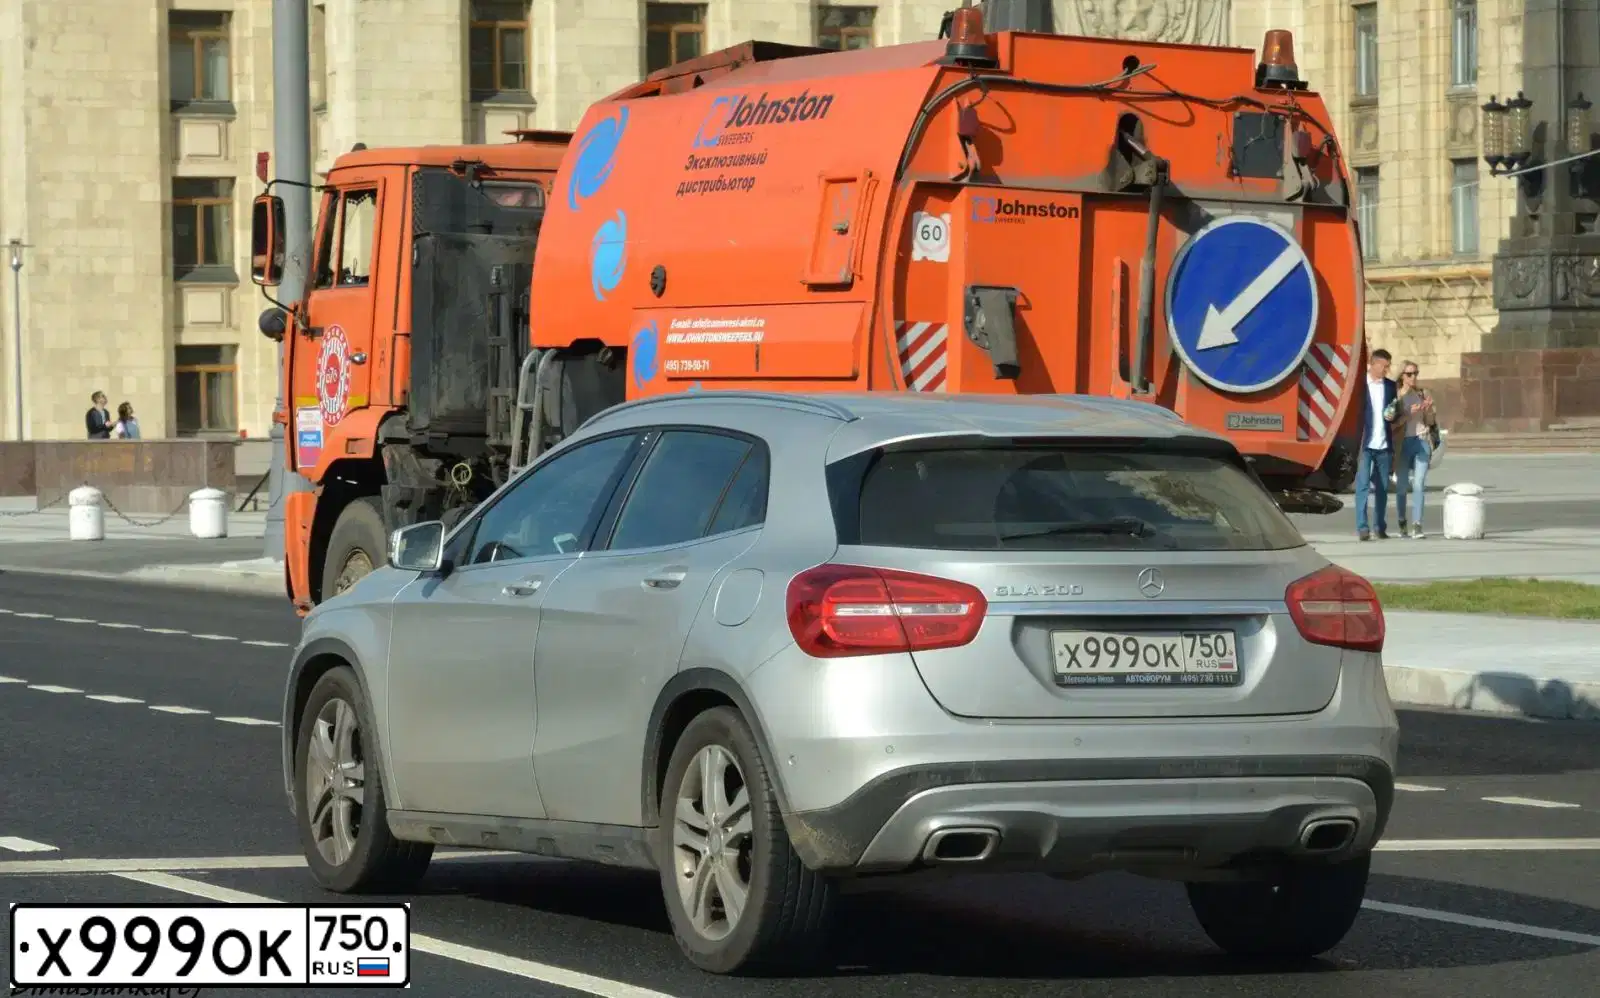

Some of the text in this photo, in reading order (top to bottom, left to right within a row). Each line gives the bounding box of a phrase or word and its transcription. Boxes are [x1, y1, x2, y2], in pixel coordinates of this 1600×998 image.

[725, 88, 834, 128] Johnston
[716, 132, 755, 146] SWEEPERS
[684, 148, 768, 170] Эксклюзивный
[676, 174, 756, 196] дистрибьютор
[995, 198, 1079, 219] Johnston
[921, 224, 942, 241] 60
[995, 584, 1084, 596] GLA 200
[1184, 634, 1227, 658] 750
[1196, 659, 1218, 668] RUS
